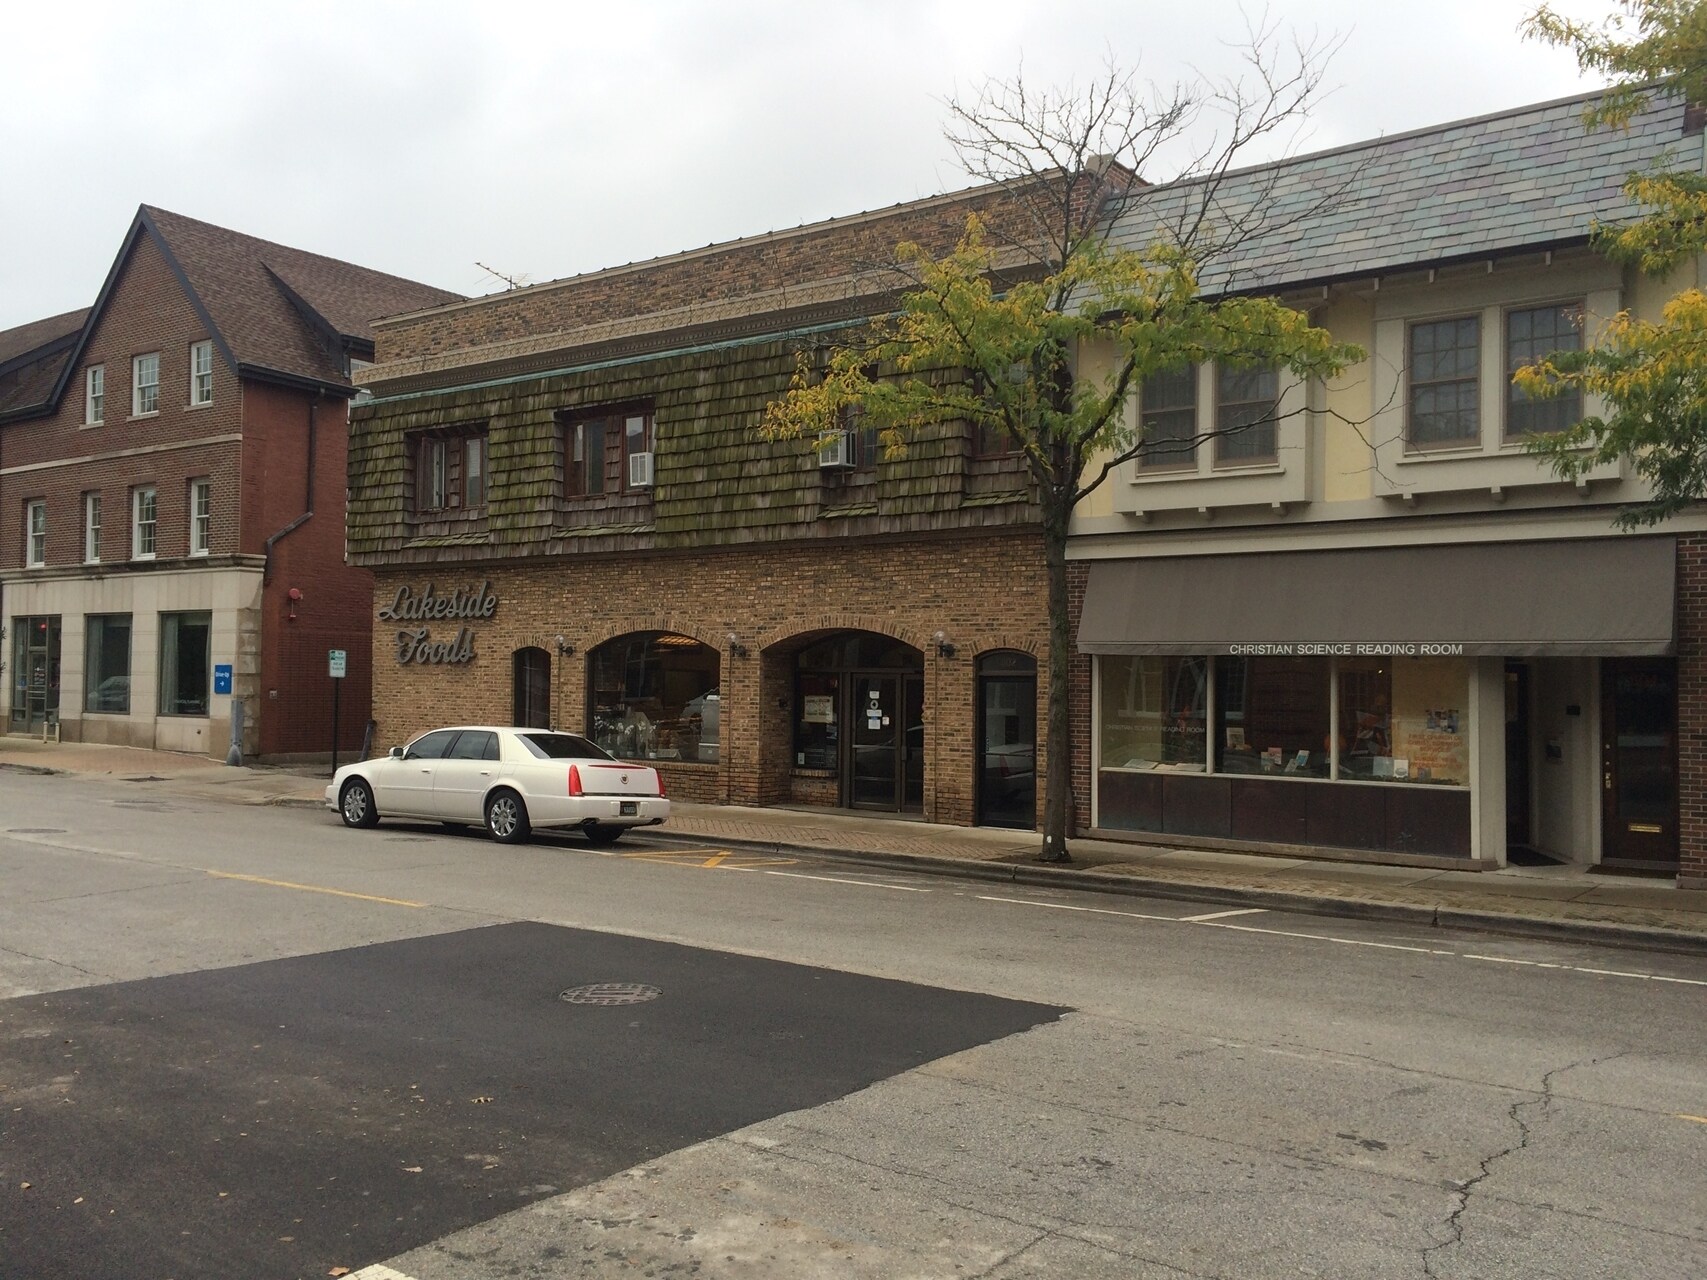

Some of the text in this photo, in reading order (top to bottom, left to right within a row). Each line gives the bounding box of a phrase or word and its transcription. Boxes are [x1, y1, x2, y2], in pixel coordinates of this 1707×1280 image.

[379, 580, 497, 620] Lakeside
[396, 626, 477, 664] Foods
[1229, 644, 1463, 655] CHRISTIAN SCIENCE READING ROOM
